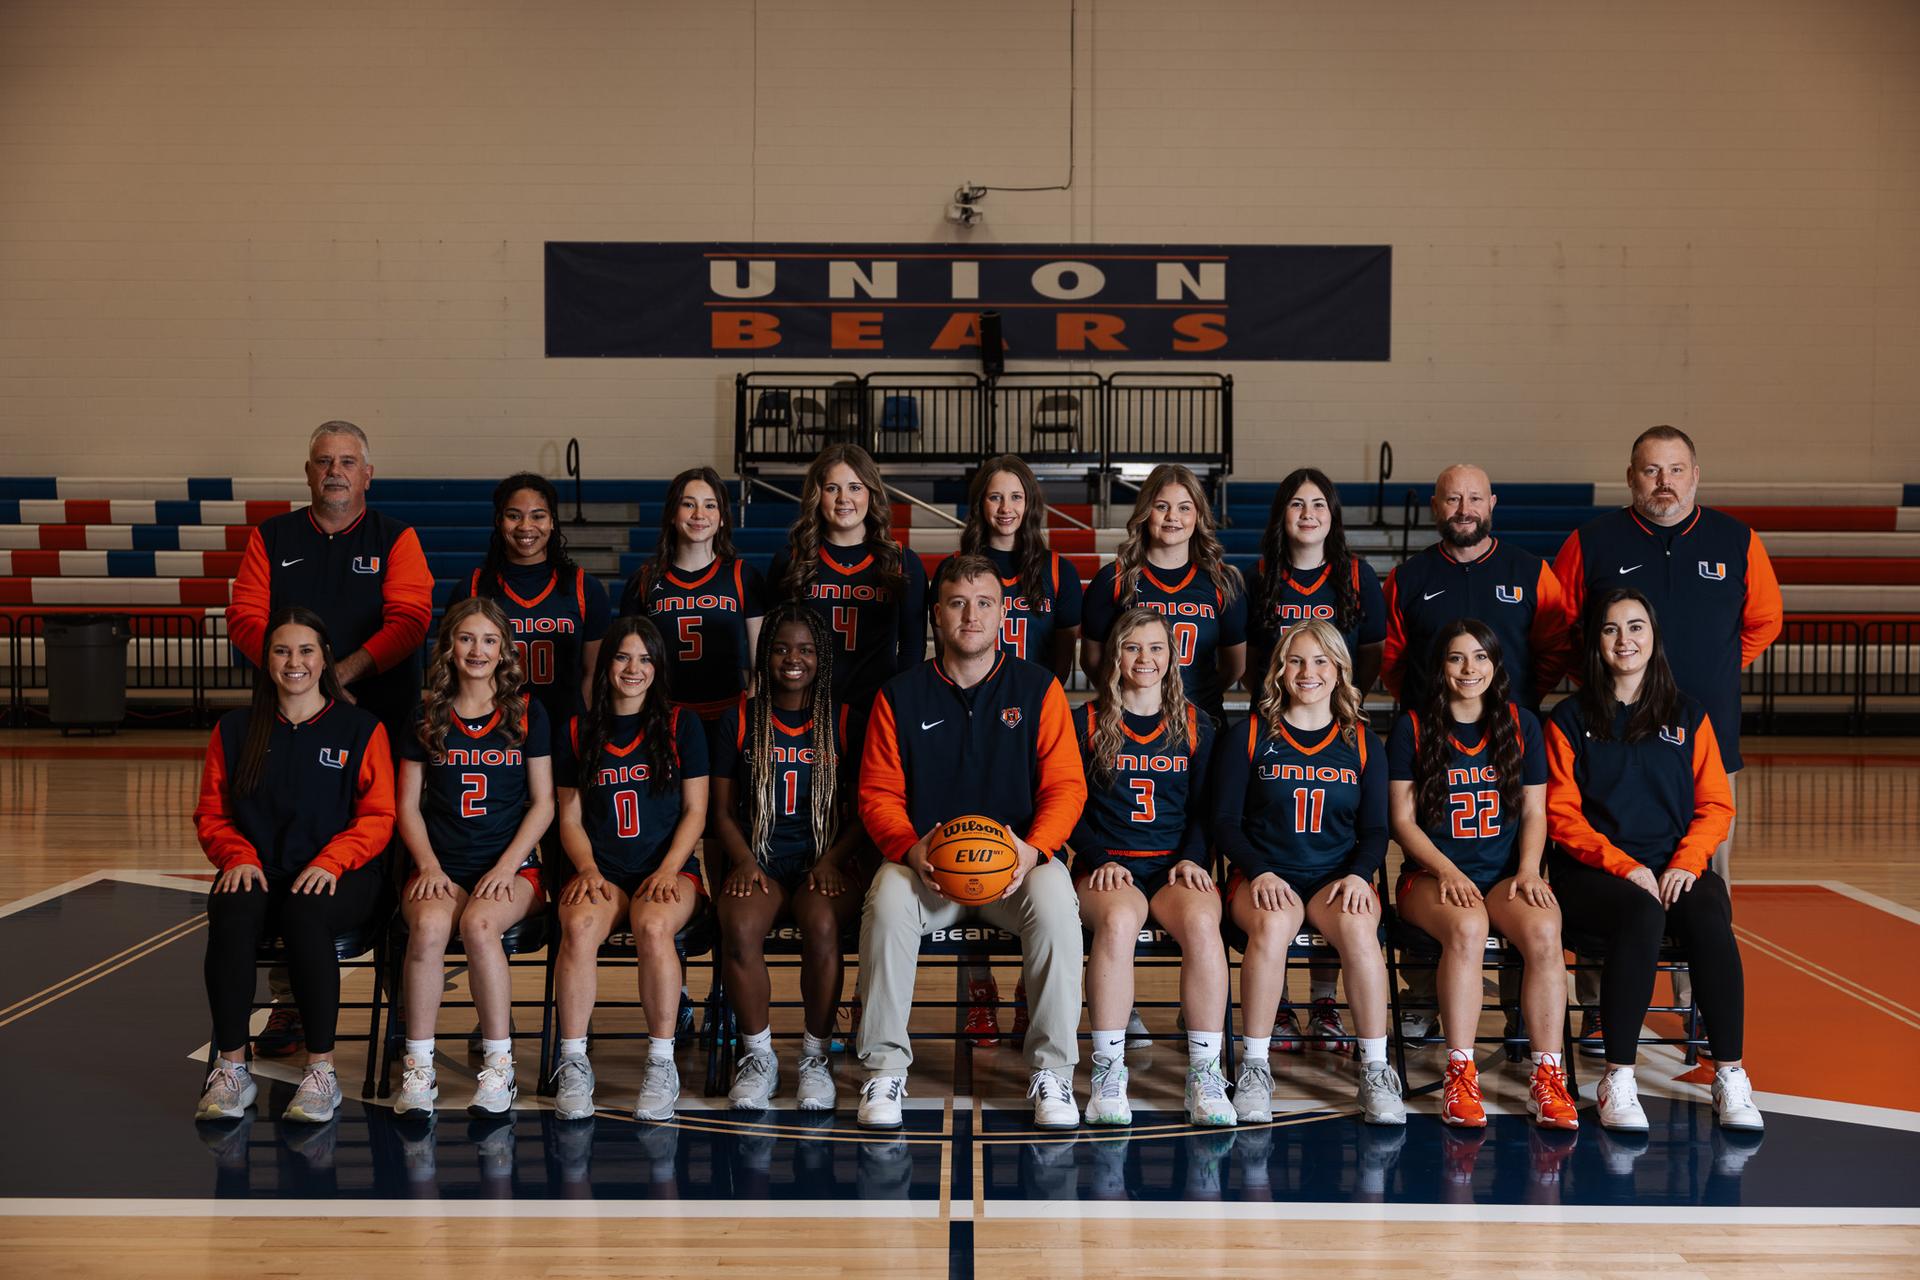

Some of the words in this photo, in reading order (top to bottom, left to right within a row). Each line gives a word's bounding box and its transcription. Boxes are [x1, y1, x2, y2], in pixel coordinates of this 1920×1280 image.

[709, 259, 1227, 301] UNION
[710, 311, 1229, 352] BEARS
[508, 617, 575, 634] NION
[832, 605, 859, 651] 4
[1125, 601, 1215, 619] NION
[1274, 604, 1335, 620] NIO
[677, 615, 703, 661] 5
[994, 617, 1028, 660] 4
[461, 772, 488, 818] 2
[596, 763, 652, 786] NIO
[783, 770, 798, 816] 1
[1258, 764, 1358, 785] UNION
[1447, 764, 1501, 786] NIO
[613, 789, 640, 838] 0
[1129, 777, 1156, 823] 3
[1293, 787, 1326, 833] 11
[1449, 789, 1501, 839] 22
[943, 820, 1004, 839] Wilson
[954, 849, 993, 863] EVO
